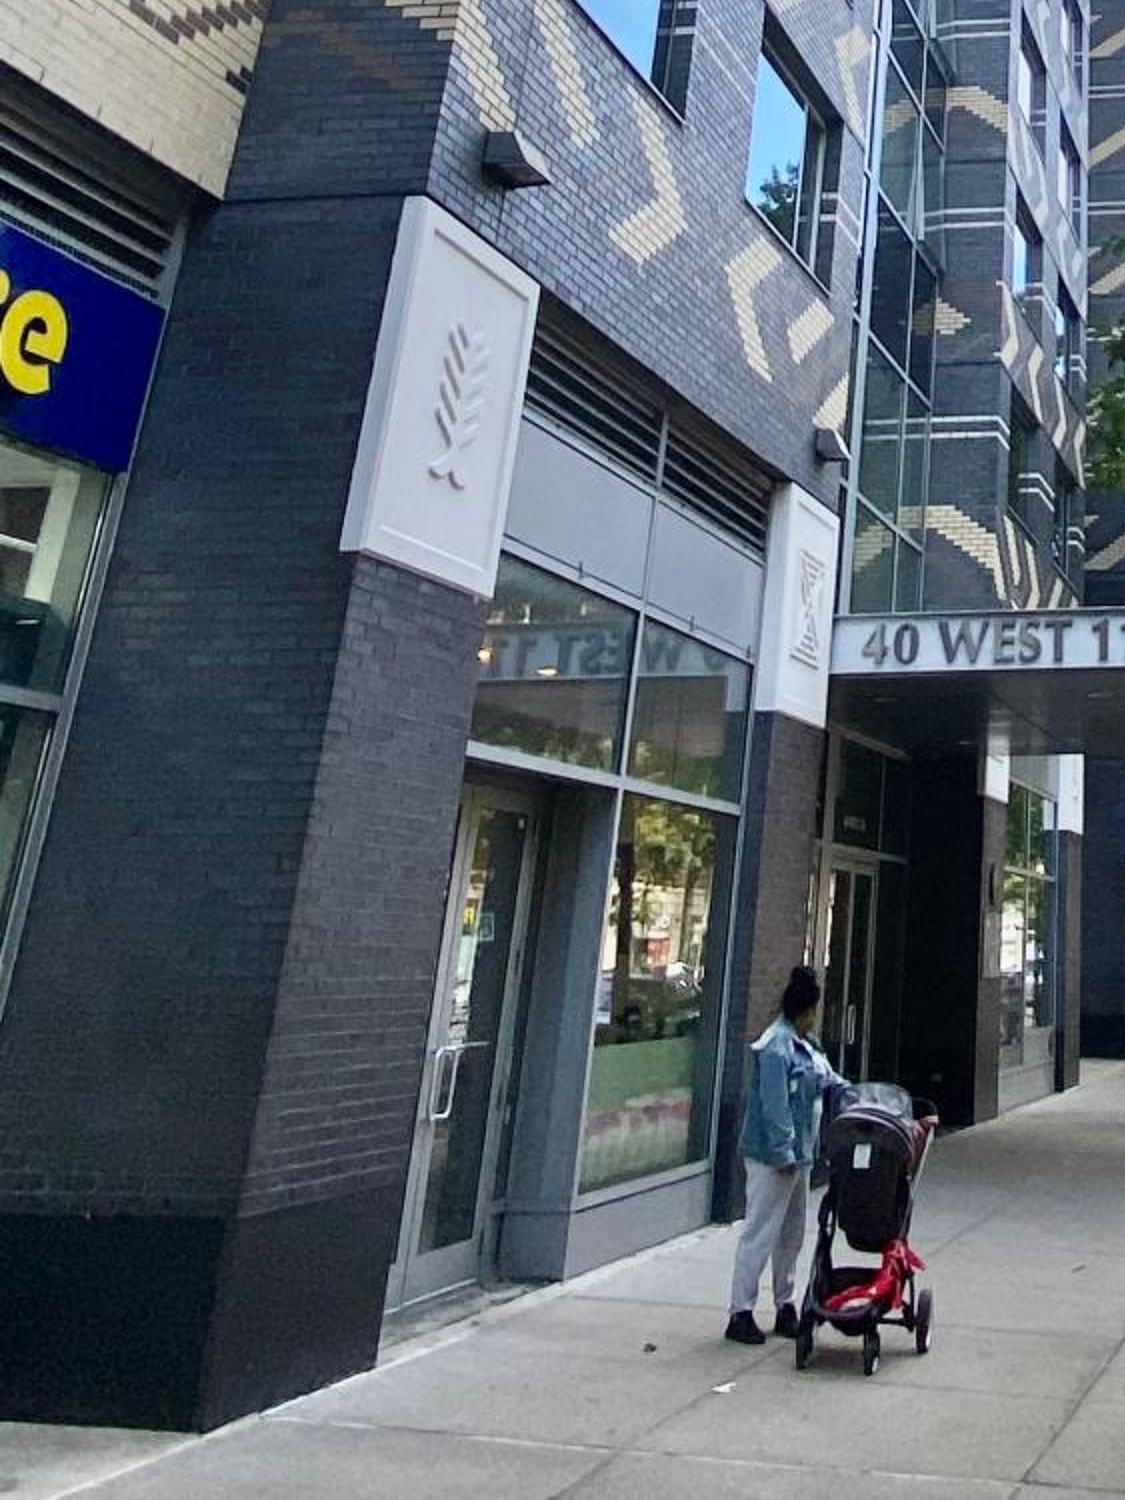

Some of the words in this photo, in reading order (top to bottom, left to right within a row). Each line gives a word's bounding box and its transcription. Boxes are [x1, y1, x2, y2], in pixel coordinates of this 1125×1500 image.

[0, 268, 67, 395] e
[861, 622, 920, 666] 40
[938, 617, 1073, 665] WEST
